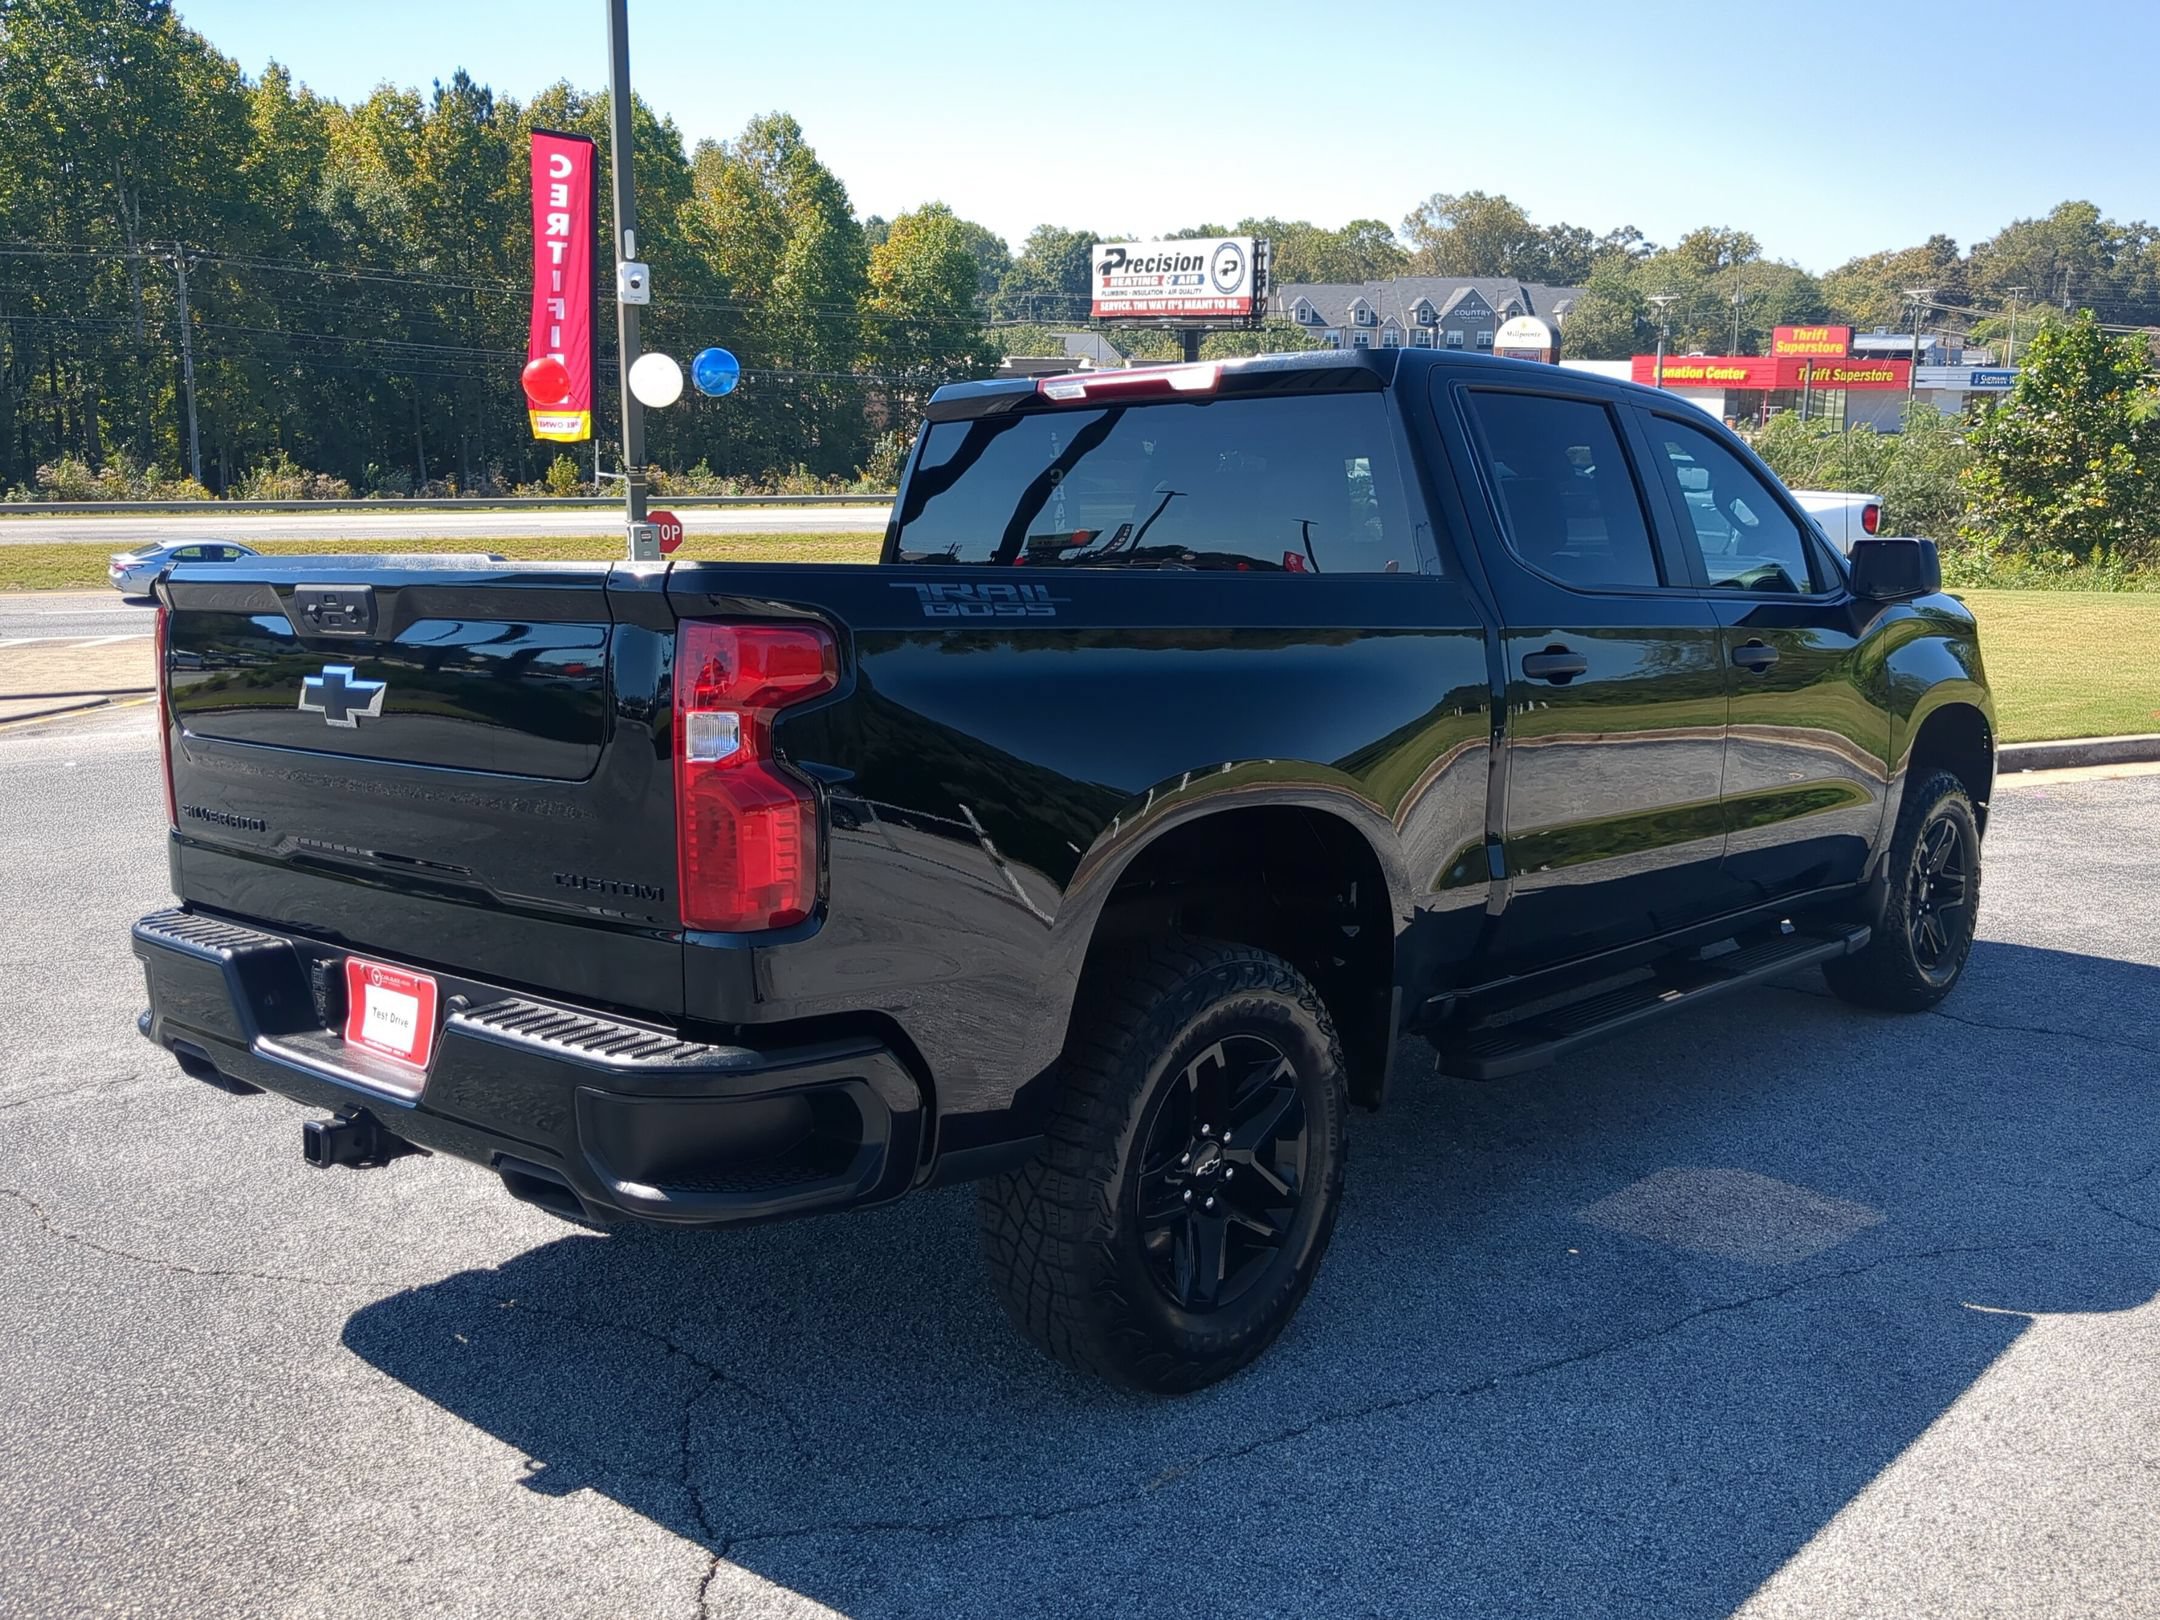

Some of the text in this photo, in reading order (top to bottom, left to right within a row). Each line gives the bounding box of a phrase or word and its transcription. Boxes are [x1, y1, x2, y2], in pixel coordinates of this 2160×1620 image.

[1097, 248, 1204, 276] Precision
[1110, 277, 1159, 287] HEATING
[1178, 275, 1200, 285] AIR
[1101, 289, 1128, 297] PLUMBING
[1179, 288, 1202, 296] QUALITY
[1133, 300, 1148, 311] THE
[1148, 300, 1167, 310] WAY
[1168, 300, 1183, 310] IT'S
[1184, 299, 1214, 310] MEANT
[1214, 299, 1226, 309] TO
[1454, 309, 1491, 317] COUNTRY
[1792, 328, 1829, 341] Thrift
[1776, 341, 1844, 355] Superstore
[1705, 366, 1747, 380] Center
[1798, 368, 1894, 383] Trift Superstore
[660, 524, 681, 541] OP
[889, 583, 1072, 602] TRAIL
[921, 602, 1056, 617] BOSS
[181, 803, 266, 833] SILVERADO
[551, 871, 665, 903] CUSTOM
[372, 1006, 409, 1029] Test Drive
